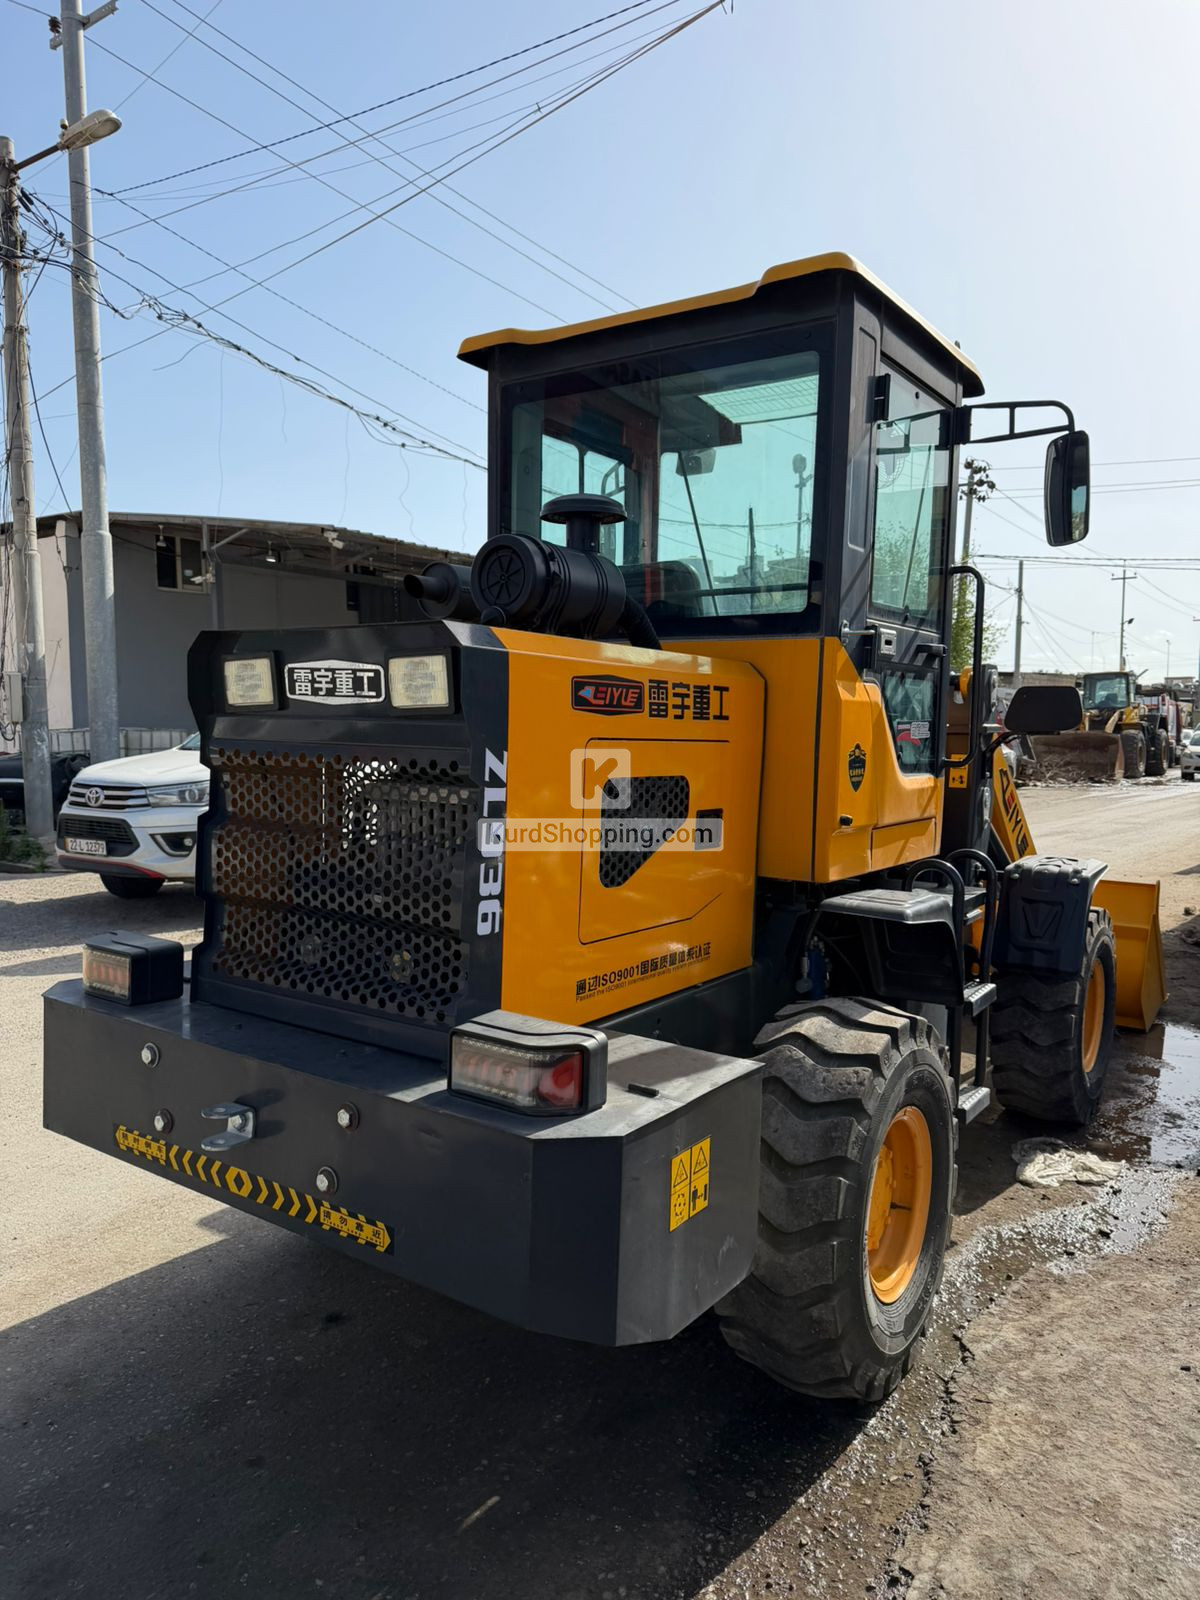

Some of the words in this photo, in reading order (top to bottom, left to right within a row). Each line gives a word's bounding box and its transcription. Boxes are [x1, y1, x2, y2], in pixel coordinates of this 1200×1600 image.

[293, 669, 377, 696] 雷宇重工
[648, 679, 729, 721] 雷宇重工
[477, 747, 508, 936] ZL936
